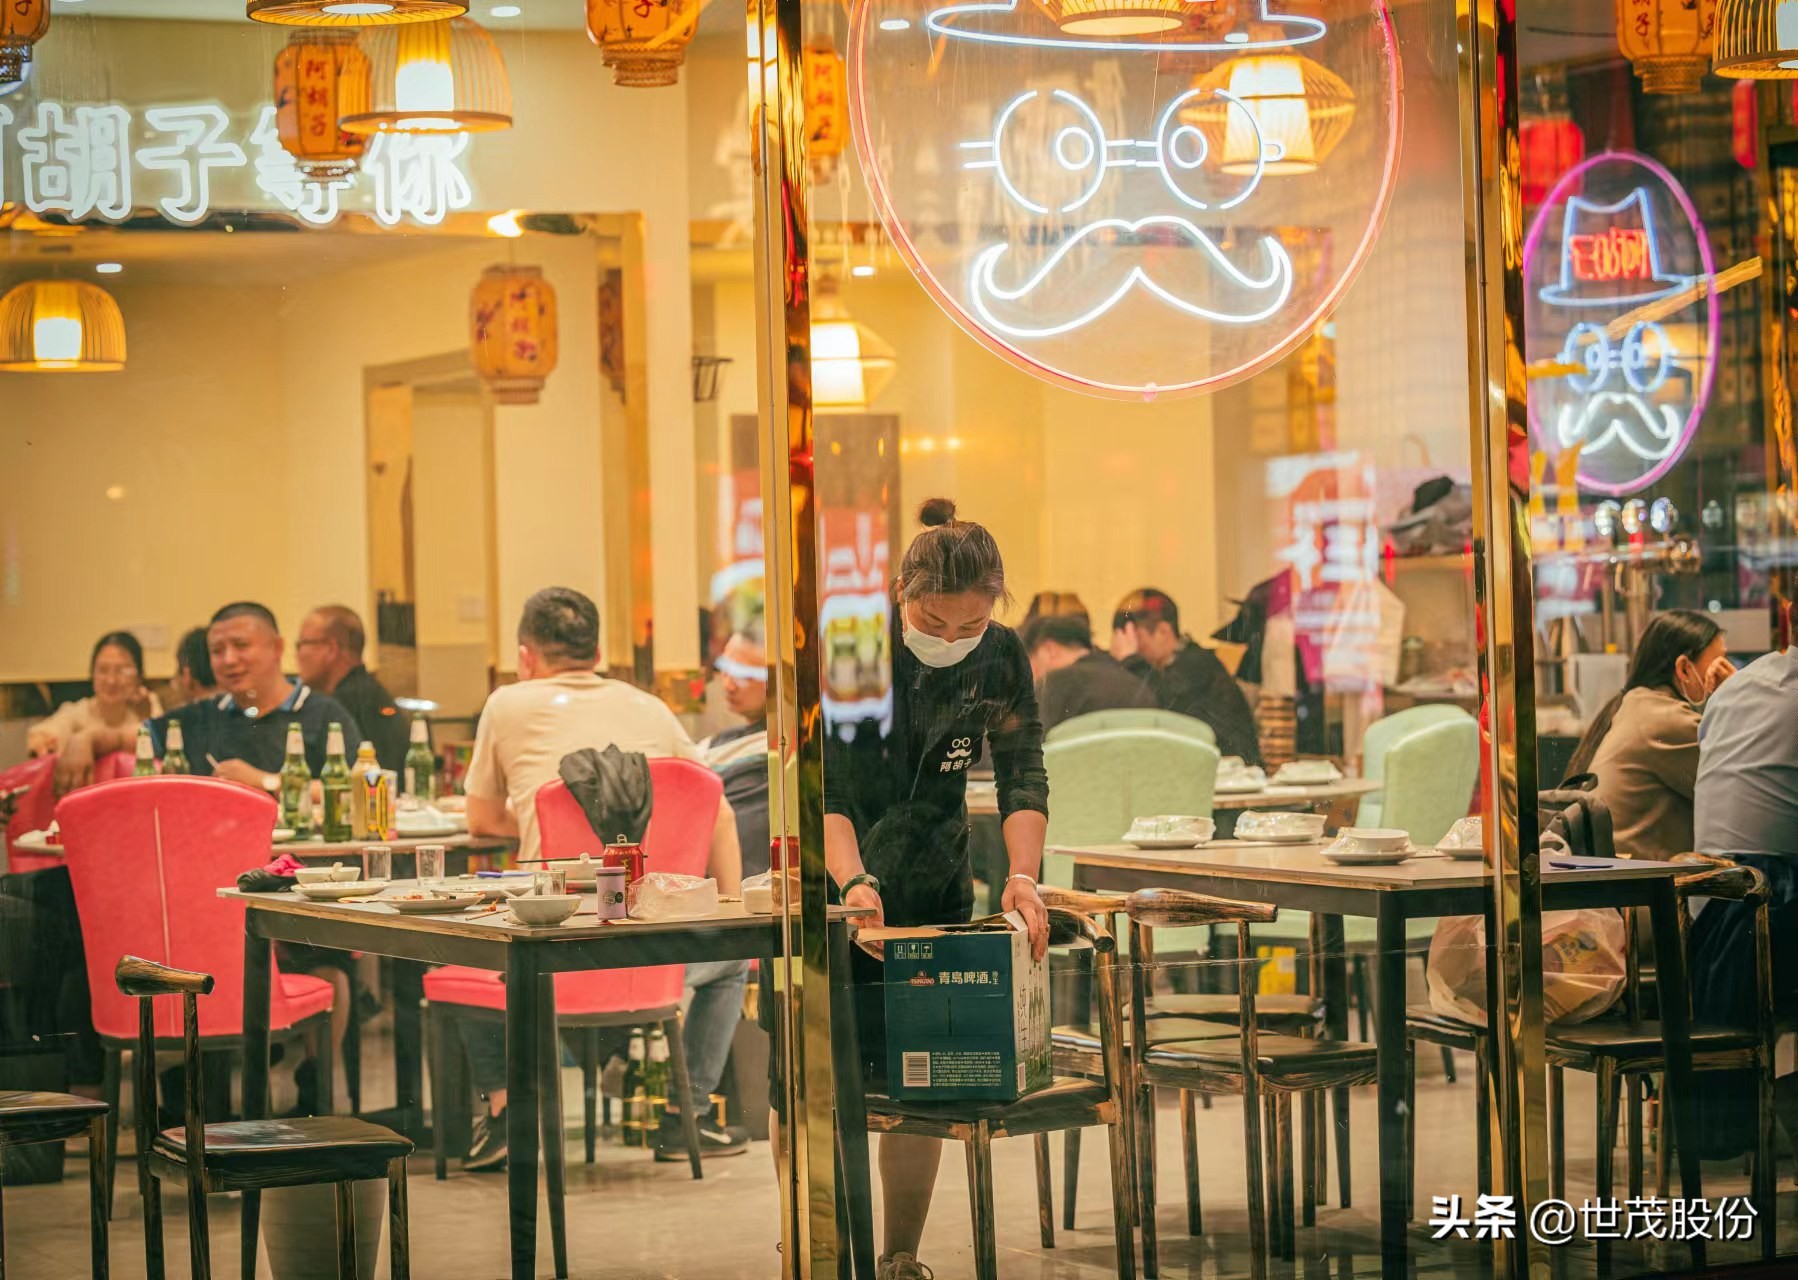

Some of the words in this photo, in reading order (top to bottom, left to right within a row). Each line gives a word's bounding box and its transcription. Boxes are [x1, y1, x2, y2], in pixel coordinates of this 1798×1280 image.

[940, 758, 972, 773] 阿胡子
[938, 971, 989, 985] 青岛啤酒
